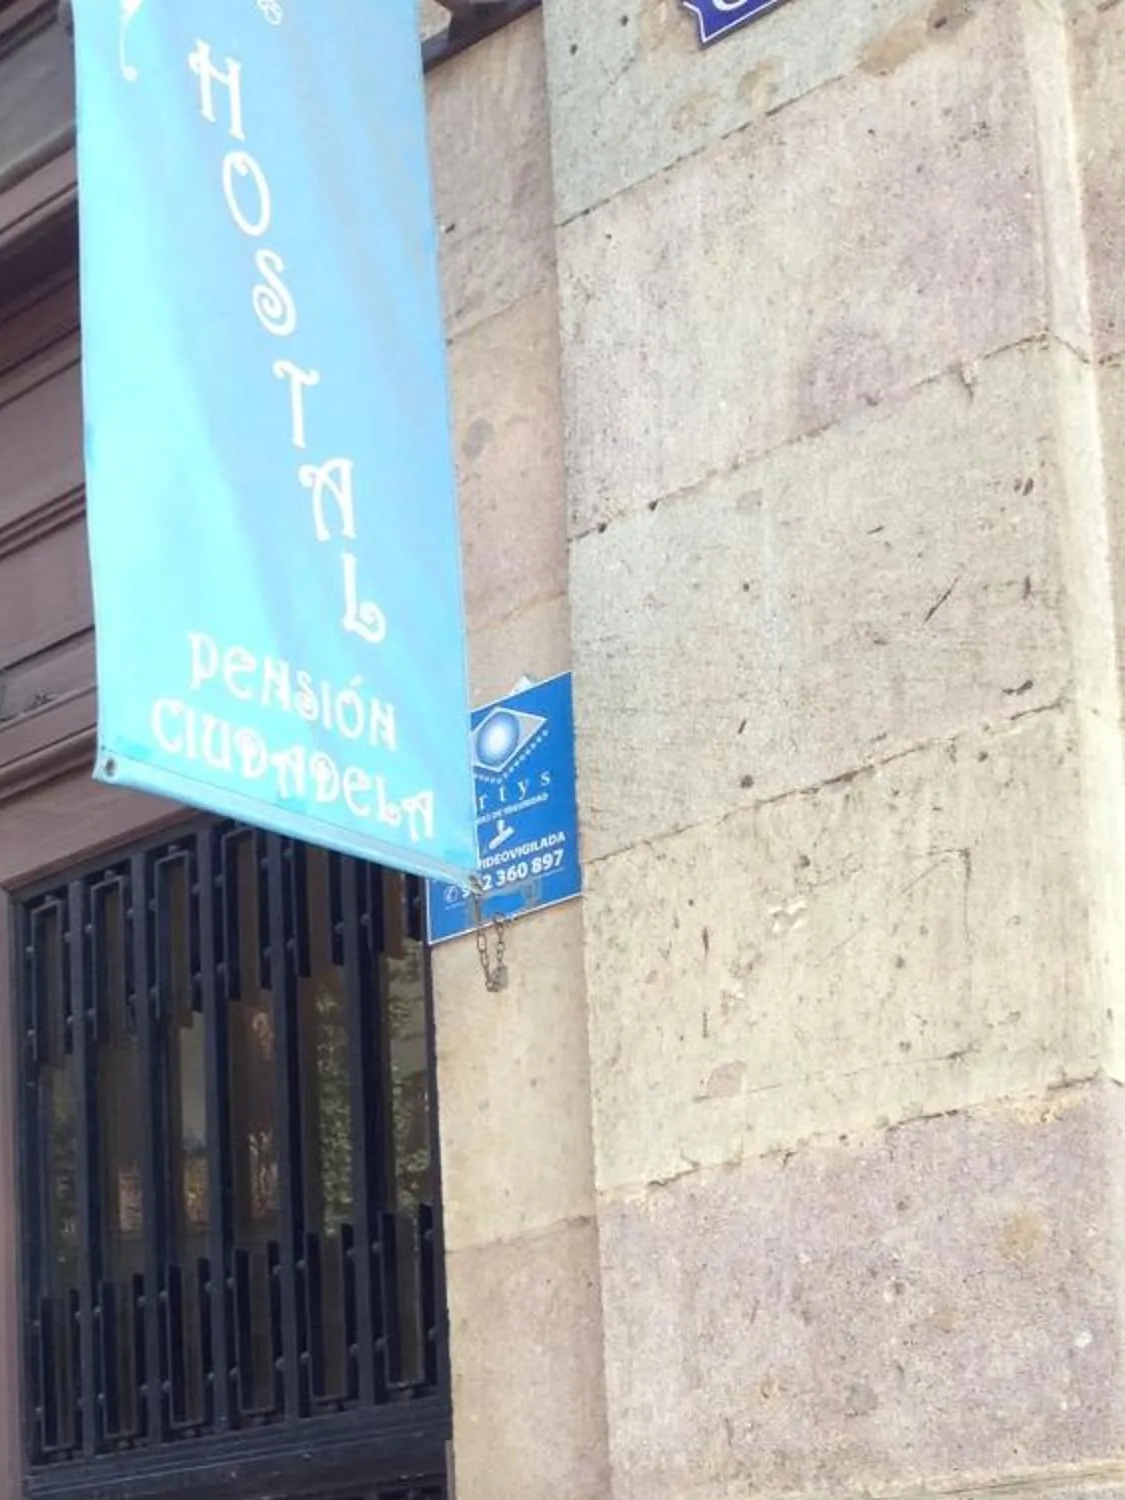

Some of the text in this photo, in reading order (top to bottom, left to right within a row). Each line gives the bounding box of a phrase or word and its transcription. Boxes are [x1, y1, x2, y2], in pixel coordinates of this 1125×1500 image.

[188, 39, 386, 643] HOSTAL
[187, 630, 397, 752] PENSIÓN
[151, 698, 435, 842] CIUDADELA
[495, 861, 528, 886] 360
[531, 850, 564, 873] 897
